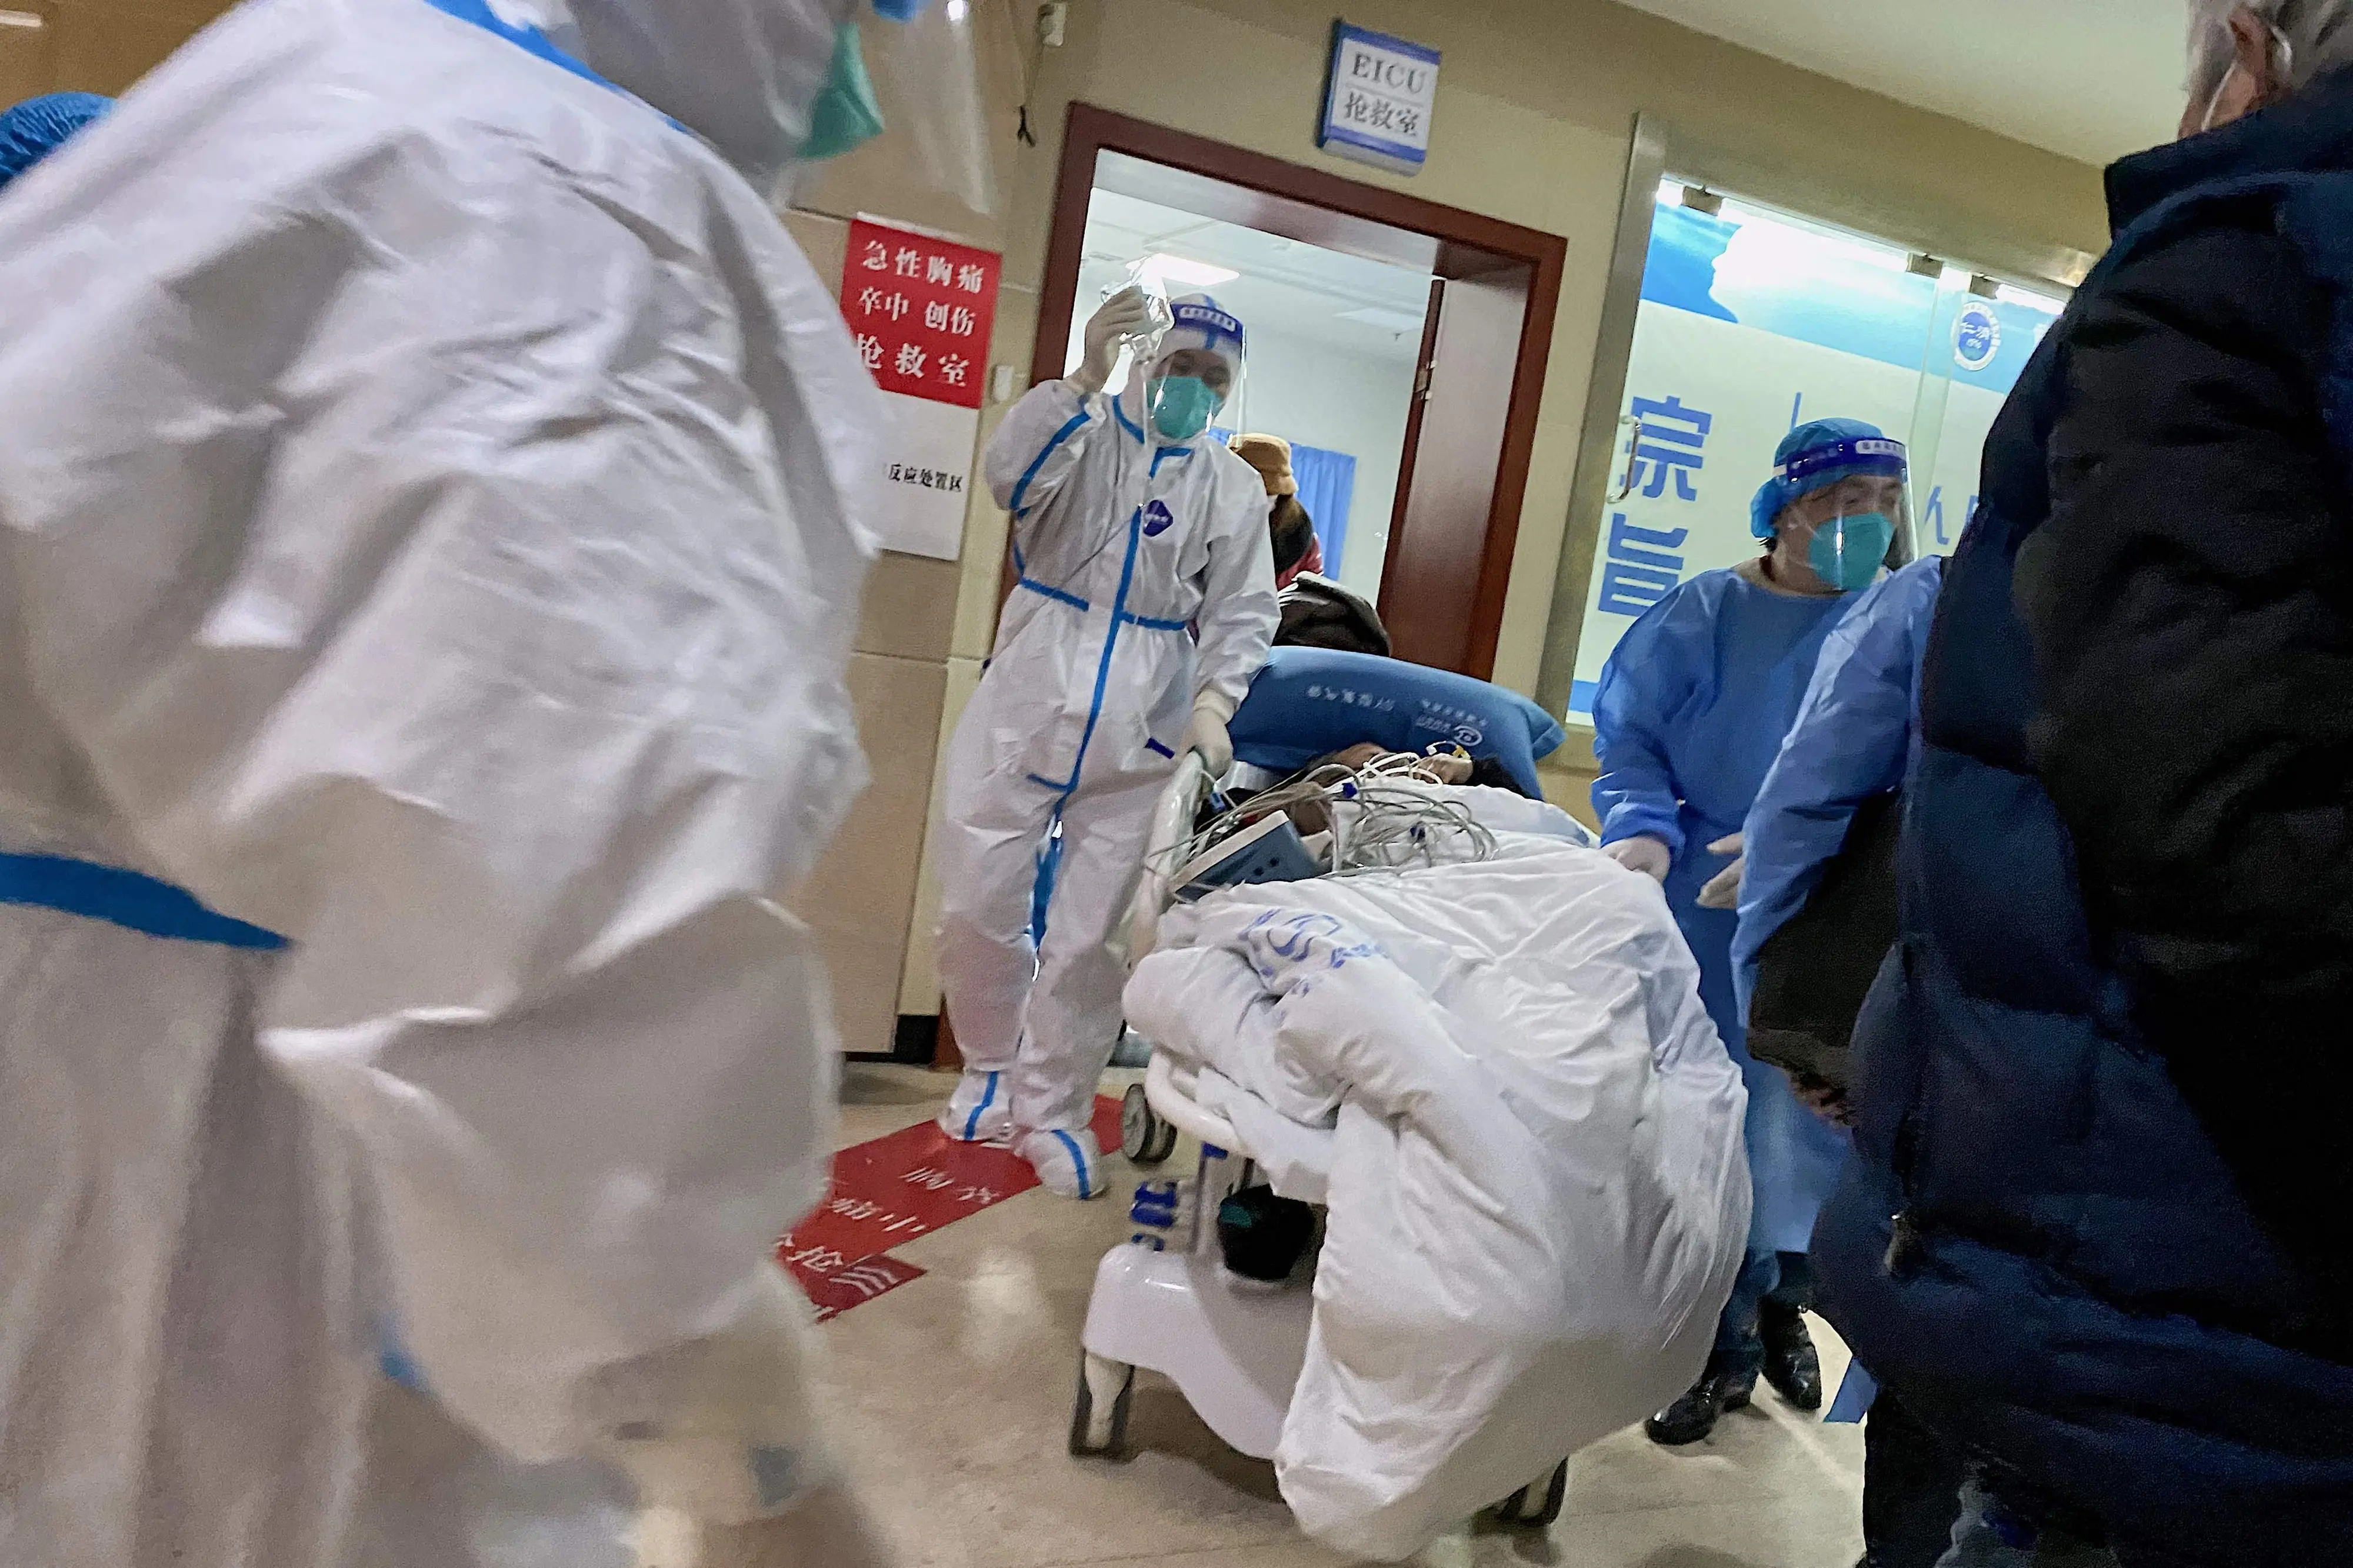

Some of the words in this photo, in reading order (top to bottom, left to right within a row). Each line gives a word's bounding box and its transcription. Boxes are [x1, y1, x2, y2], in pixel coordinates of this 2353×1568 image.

[1353, 52, 1428, 94] EICU
[1344, 91, 1419, 136] 抢救室
[861, 239, 985, 294] 急性胸痛
[858, 286, 909, 322] 卒中
[924, 300, 976, 336] 创伤
[856, 332, 969, 387] 抢救室
[882, 463, 963, 492] 反应处置区
